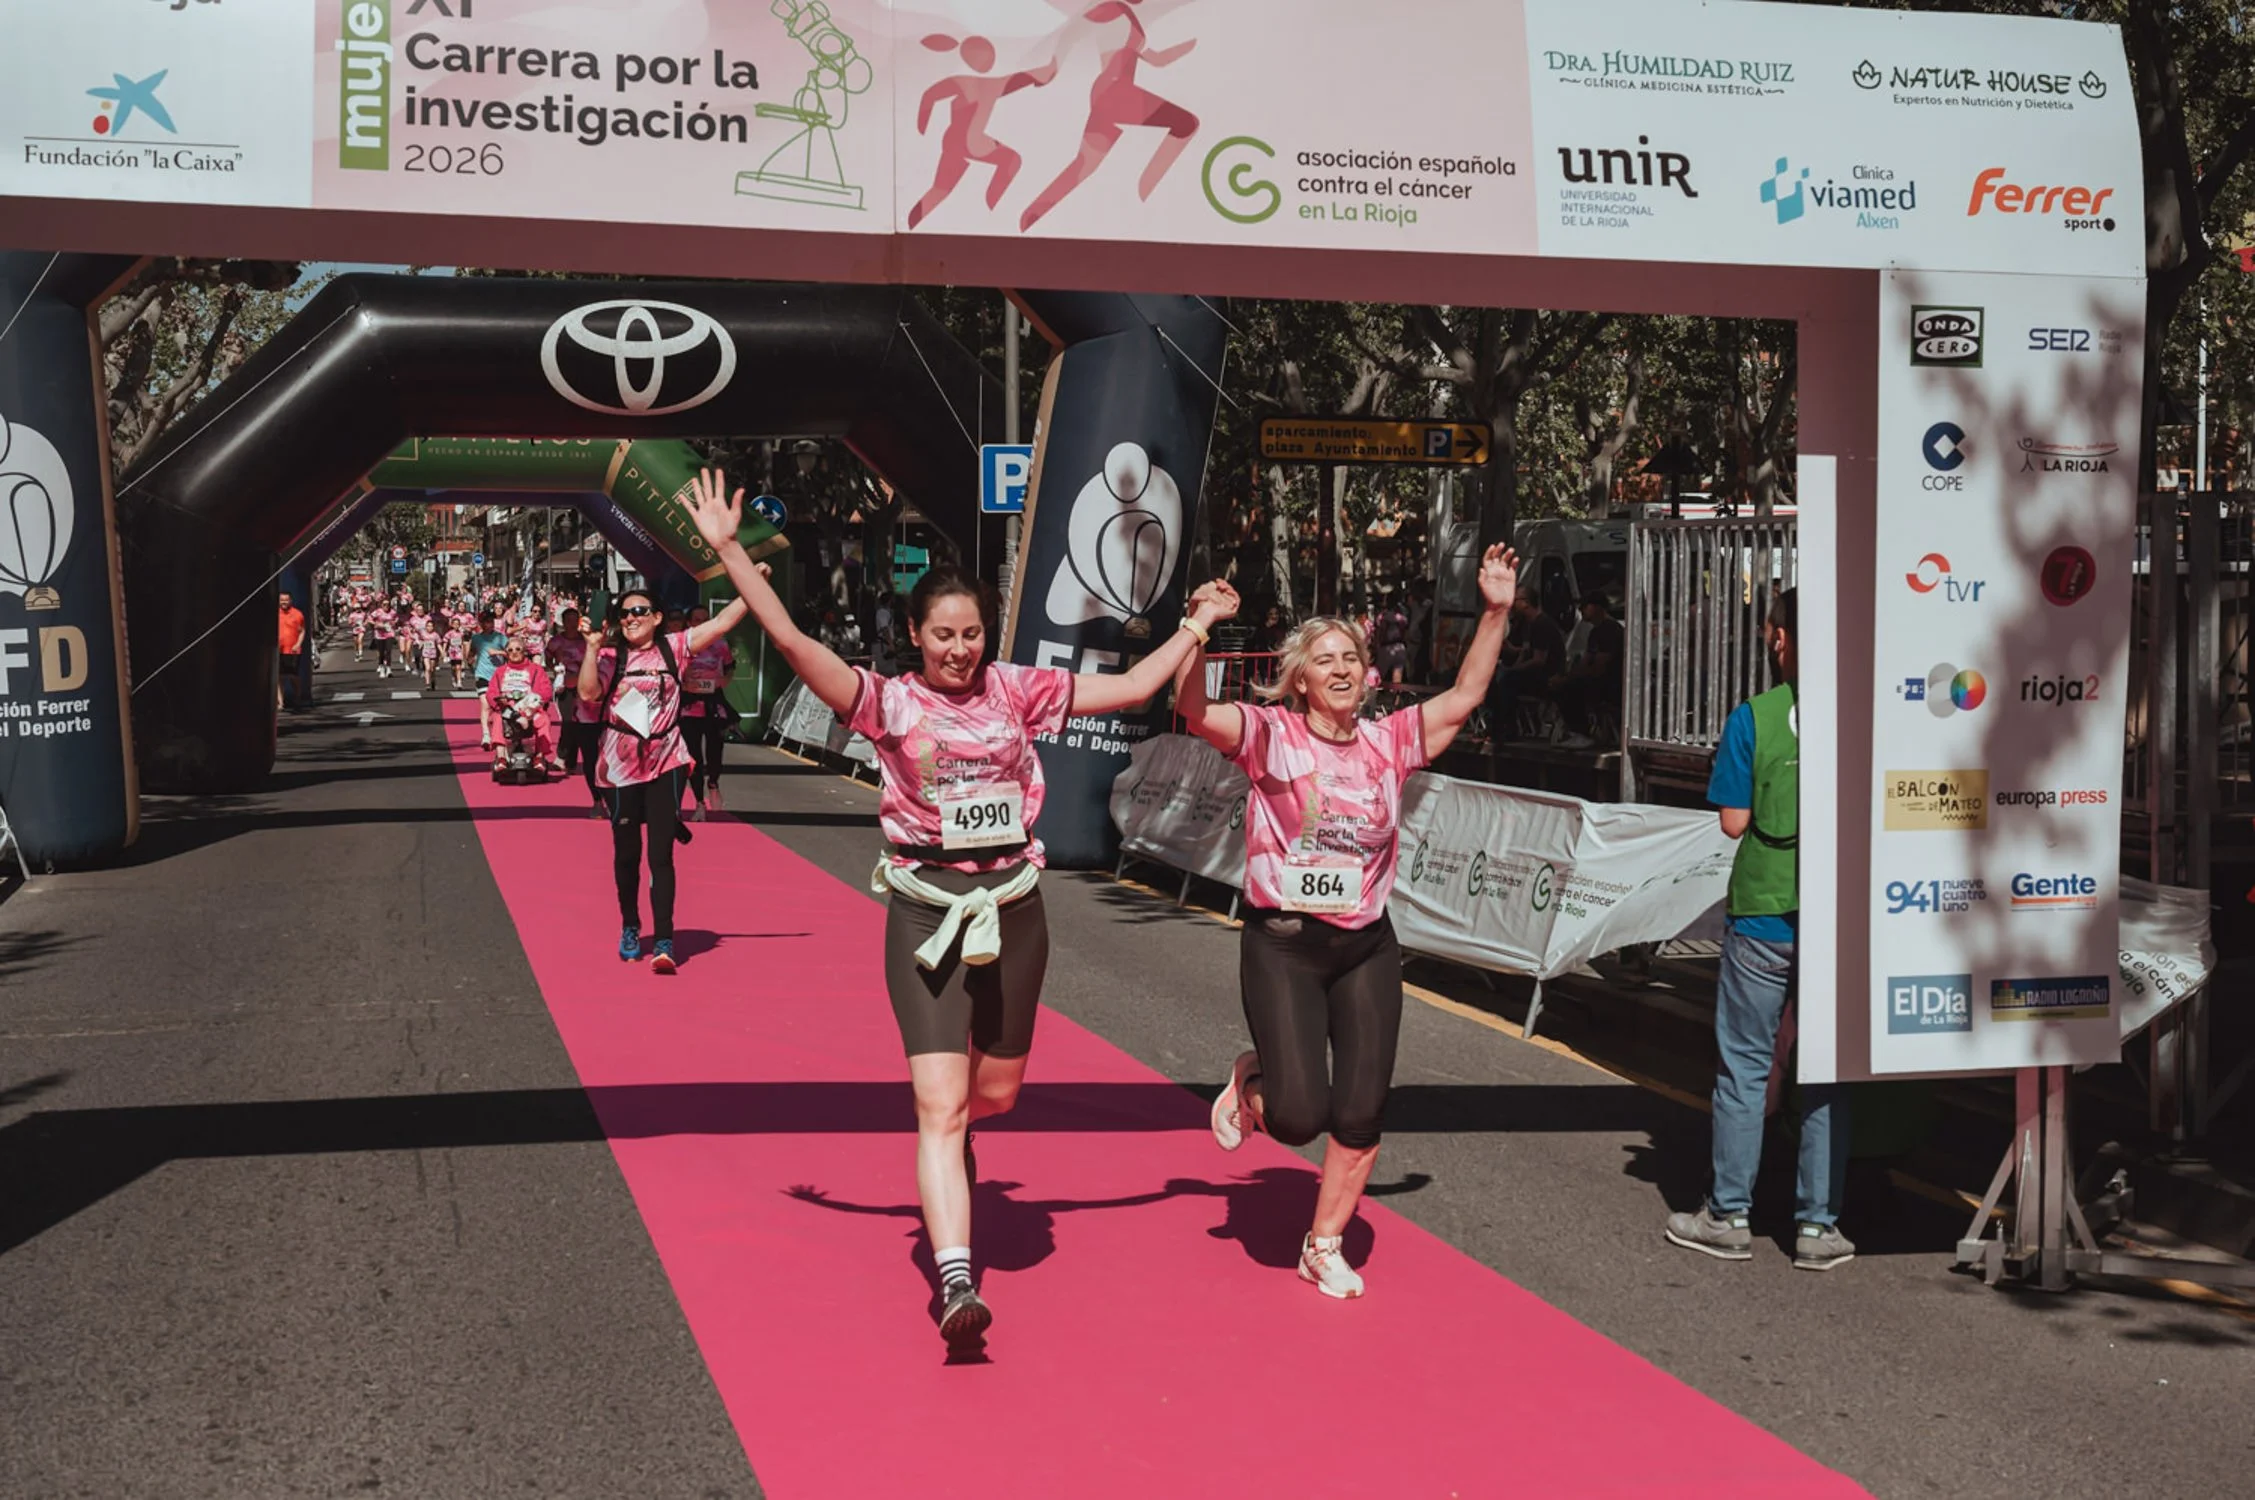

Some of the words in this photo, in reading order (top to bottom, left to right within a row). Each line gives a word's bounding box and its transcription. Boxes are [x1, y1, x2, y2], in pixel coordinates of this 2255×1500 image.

[405, 32, 600, 80] Carrera
[615, 52, 701, 92] por
[712, 50, 759, 89] la
[1740, 61, 1795, 84] RUIZ
[1641, 81, 1703, 93] MEDICINA
[1707, 84, 1764, 96] ESTÉTICA
[1890, 66, 1980, 90] NATUR
[1987, 70, 2072, 95] HOUSE
[1893, 94, 1942, 107] Expertos
[1945, 97, 1959, 106] en
[1961, 96, 2013, 107] Nutrición
[2016, 101, 2023, 110] y
[2025, 98, 2074, 110] Dietética
[404, 87, 749, 146] investigación
[24, 144, 138, 168] Fundación
[403, 143, 505, 176] 2026
[1296, 149, 1412, 171] asociación
[1418, 155, 1517, 177] española
[1297, 176, 1368, 194] contra
[1374, 178, 1392, 196] el
[1398, 178, 1473, 200] cáncer
[1560, 190, 1637, 203] UNIVERSIDAD
[1810, 179, 1916, 211] viamed
[1298, 204, 1325, 219] en
[1331, 202, 1359, 221] La
[1363, 203, 1418, 227] Rioja
[1561, 203, 1654, 217] INTERNACIONAL
[1562, 216, 1577, 227] DE
[1580, 216, 1595, 228] LA
[1597, 216, 1630, 228] RIOJA
[1921, 319, 1973, 333] ONDA
[1925, 340, 1971, 354] CERO
[2028, 328, 2091, 352] SER
[1313, 441, 1417, 457] Ayuntamiento
[1428, 430, 1448, 455] P
[2043, 459, 2062, 472] LA
[2065, 459, 2109, 473] RIOJA
[995, 453, 1032, 504] P
[1922, 475, 1963, 491] COPE
[624, 467, 714, 562] PITILLOS
[1944, 575, 1986, 602] tvr
[2020, 674, 2100, 707] rioja2
[37, 699, 91, 716] Ferrer
[19, 716, 91, 738] Deporte
[1066, 734, 1083, 748] el
[935, 756, 990, 770] Carrera
[1938, 797, 1983, 813] MATEO
[1996, 790, 2057, 809] europa
[2060, 788, 2108, 808] press
[954, 802, 1011, 830] 4990
[1320, 809, 1368, 825] Carrera
[1317, 828, 1341, 840] por
[1301, 873, 1345, 897] 864
[1942, 878, 1984, 890] nueve
[1942, 889, 1987, 901] cuatro
[2011, 873, 2097, 897] Gente
[1942, 901, 1969, 912] uno
[1895, 984, 1918, 1016] El
[1922, 986, 1967, 1015] Día
[1920, 1015, 1932, 1025] de
